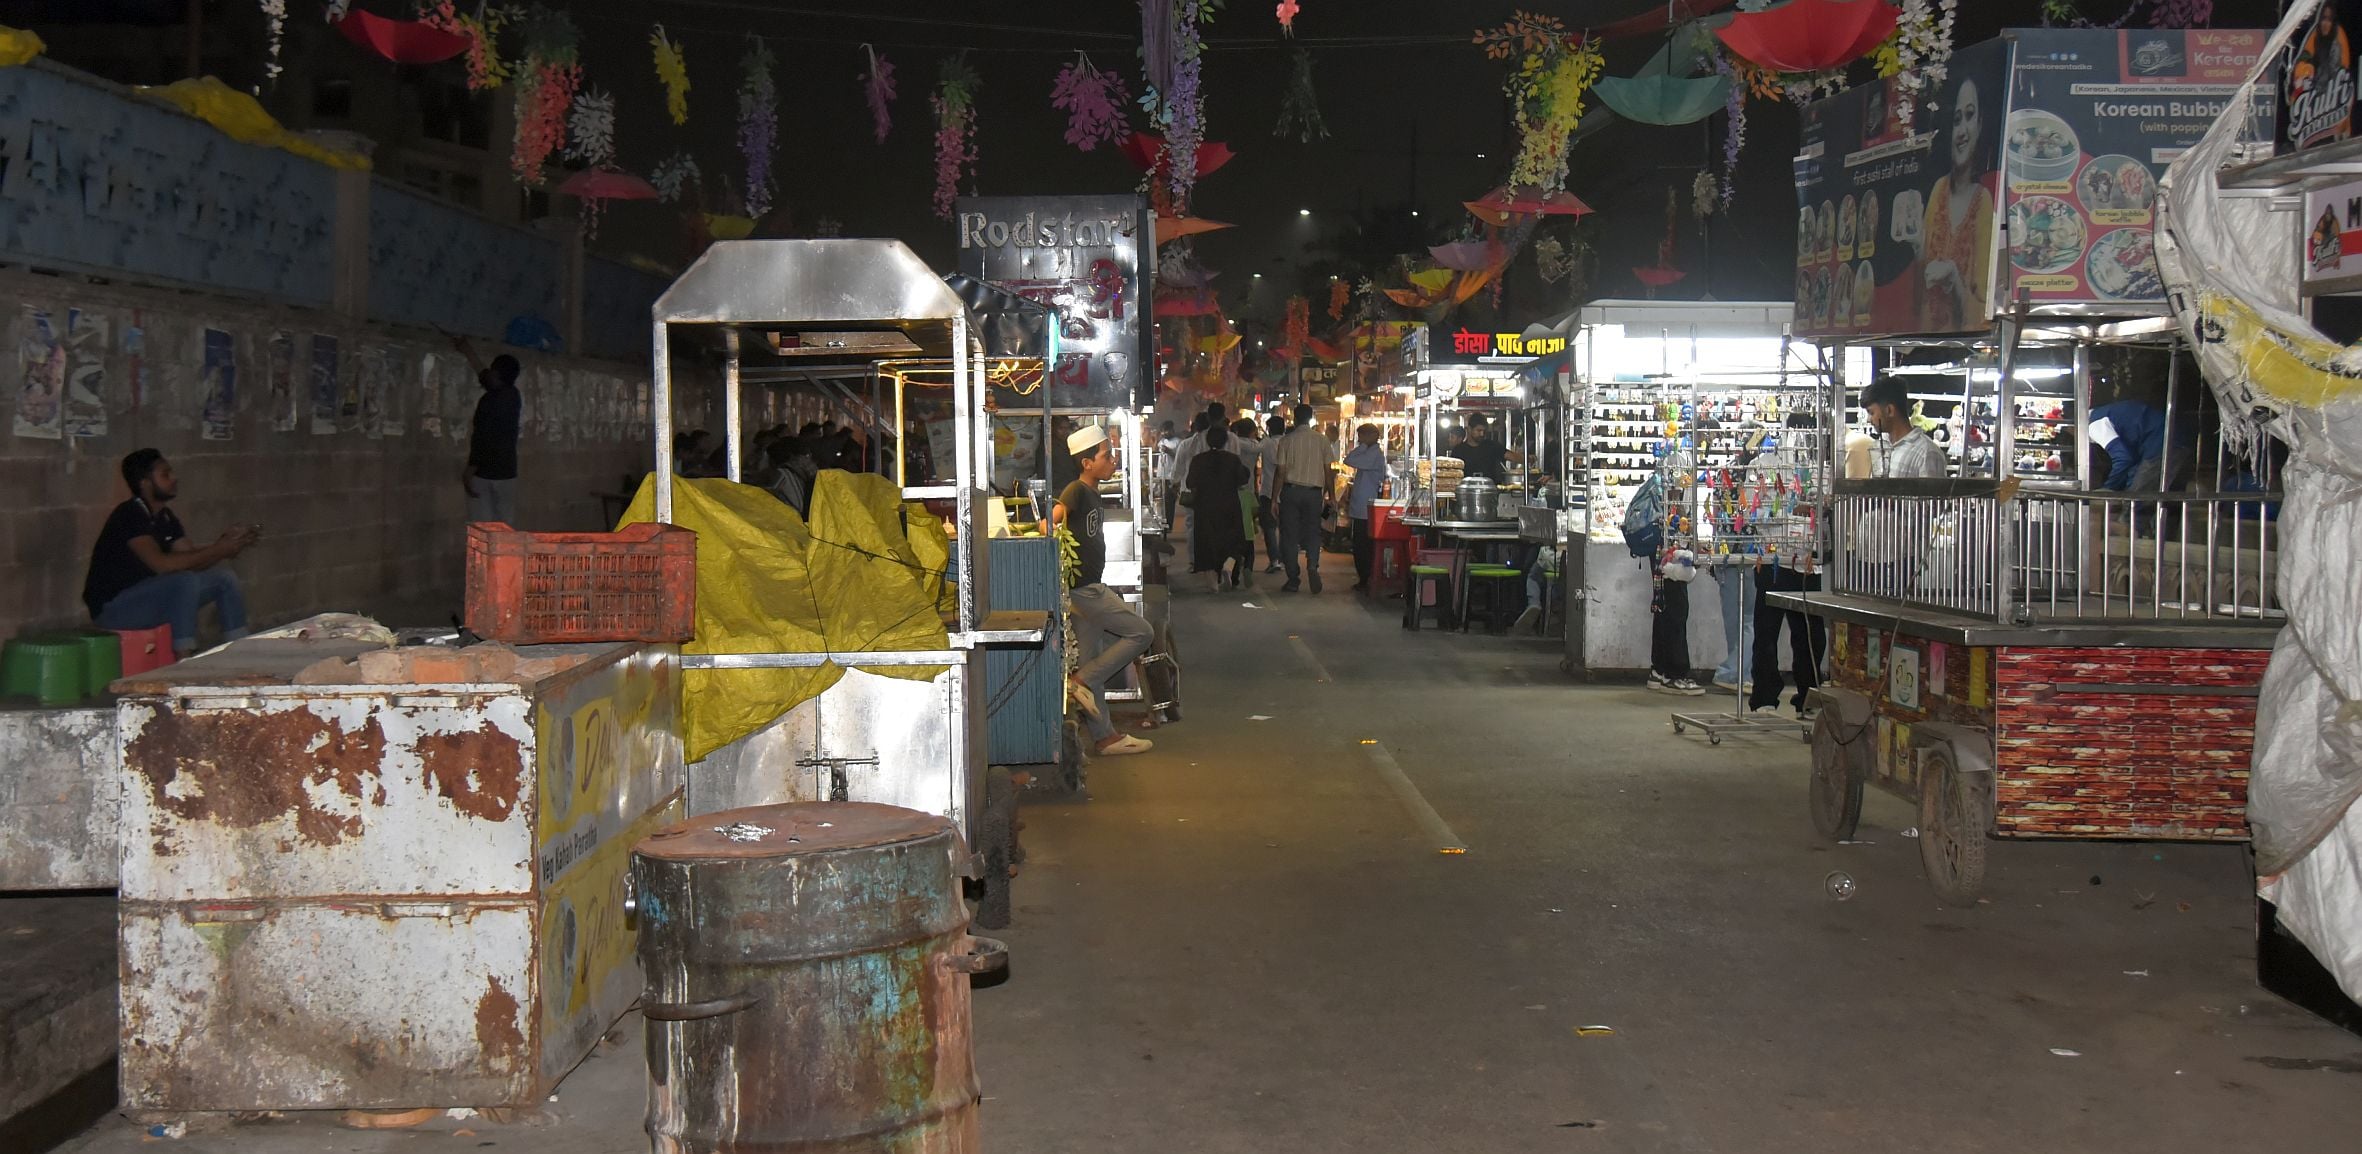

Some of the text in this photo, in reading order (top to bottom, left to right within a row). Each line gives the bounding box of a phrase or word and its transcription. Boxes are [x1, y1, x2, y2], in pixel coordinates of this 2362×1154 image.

[2193, 52, 2258, 66] Korean
[2094, 101, 2165, 117] Korean
[2289, 69, 2353, 136] Kulfi
[2139, 121, 2211, 134] (with poppin
[960, 211, 1120, 249] Rodstar
[1452, 327, 1490, 355] डोसा
[541, 855, 554, 885] Veg
